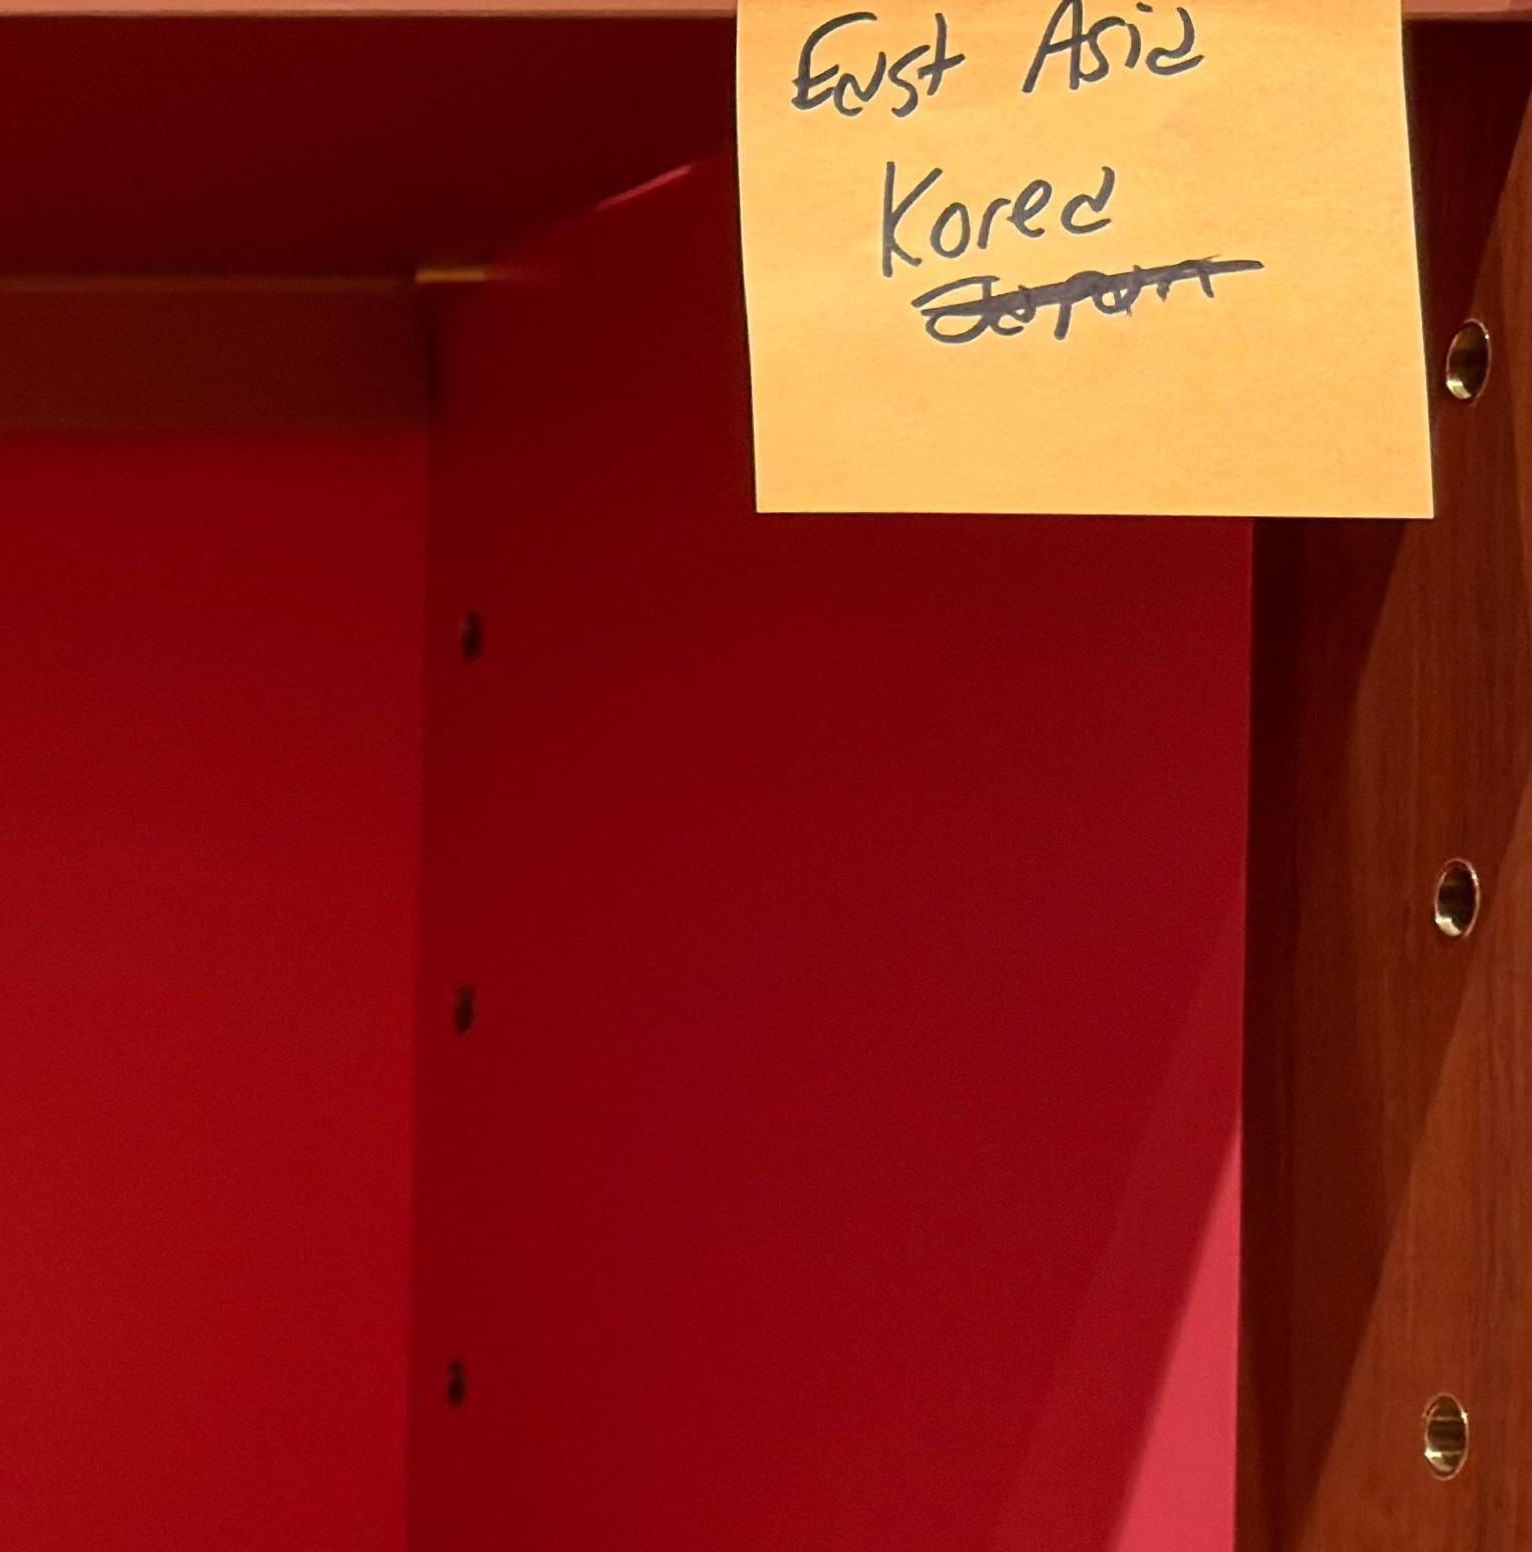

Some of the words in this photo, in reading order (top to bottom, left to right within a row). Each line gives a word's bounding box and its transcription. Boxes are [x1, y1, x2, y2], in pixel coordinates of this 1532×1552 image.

[792, 11, 965, 119] East
[1022, 0, 1206, 93] Asia
[881, 161, 1116, 278] Korea
